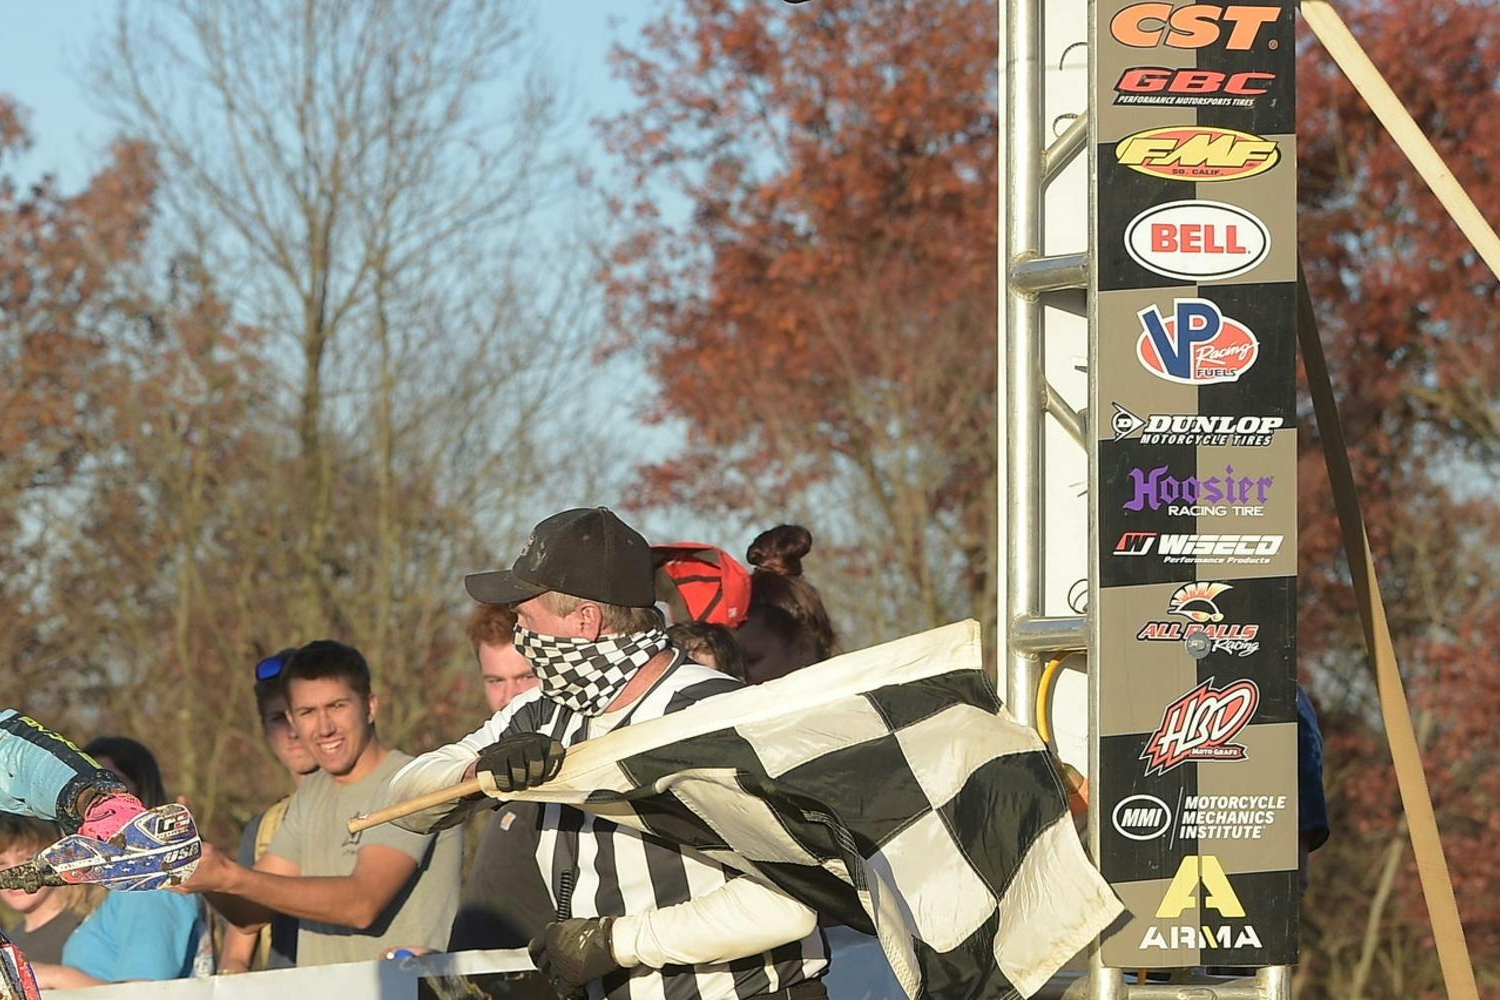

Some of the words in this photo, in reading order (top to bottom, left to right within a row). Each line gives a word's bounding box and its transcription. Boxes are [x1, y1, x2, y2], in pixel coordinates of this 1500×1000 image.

[1110, 2, 1281, 50] CST
[1116, 68, 1276, 95] GBC
[1117, 95, 1174, 105] PERFORMANCE
[1176, 96, 1230, 106] MOTORSPORTS
[1232, 98, 1255, 107] TIRES
[1117, 133, 1278, 167] FMF
[1150, 223, 1246, 254] BELL
[1142, 302, 1220, 379] VP
[1196, 341, 1260, 367] Racing
[1197, 367, 1236, 378] FUELS
[1144, 415, 1284, 434] DUNLOP
[1140, 434, 1228, 446] MOTORCYCLE
[1232, 434, 1272, 446] TIRES
[1122, 464, 1274, 512] Hoosier
[1168, 505, 1228, 517] RACING
[1233, 506, 1264, 517] TIRE
[1163, 556, 1225, 565] Performance
[1227, 556, 1271, 565] Products
[1138, 623, 1181, 640] ALL
[1211, 639, 1260, 657] Racing
[1121, 808, 1163, 827] MMI
[1184, 796, 1287, 809] MOTORCYCLE
[1181, 810, 1275, 824] MECHANICS
[1179, 825, 1262, 839] INSTITUTE
[1138, 925, 1264, 950] ARMA
